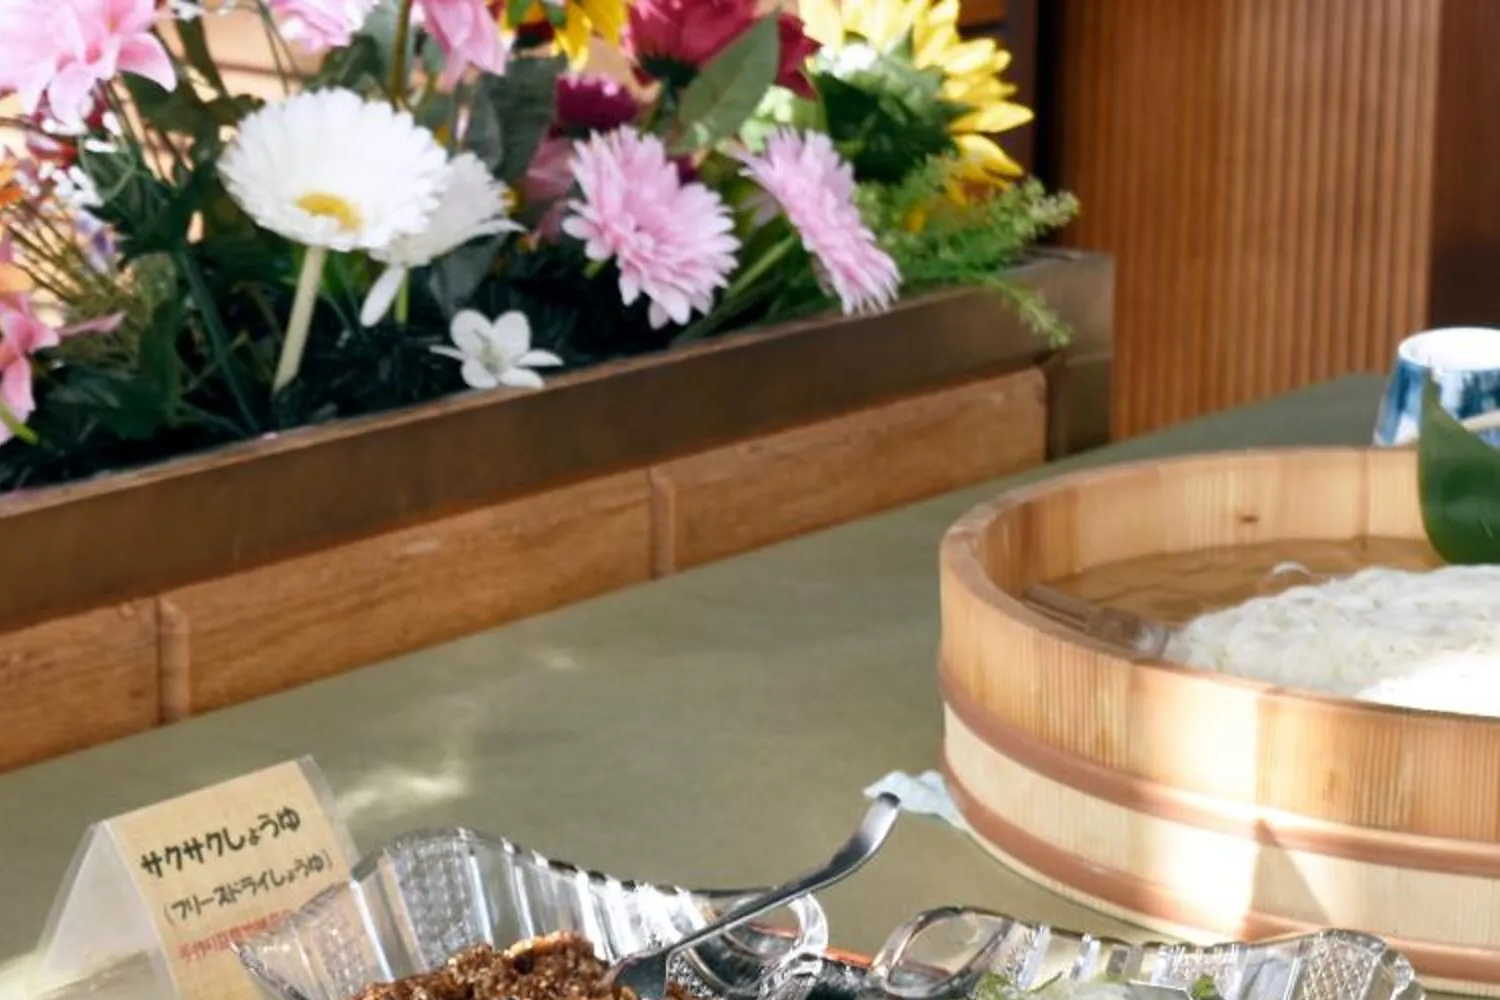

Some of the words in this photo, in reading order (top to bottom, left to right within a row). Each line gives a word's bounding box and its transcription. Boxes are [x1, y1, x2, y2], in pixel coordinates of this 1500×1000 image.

[141, 806, 301, 877] サクサクしょうゆ
